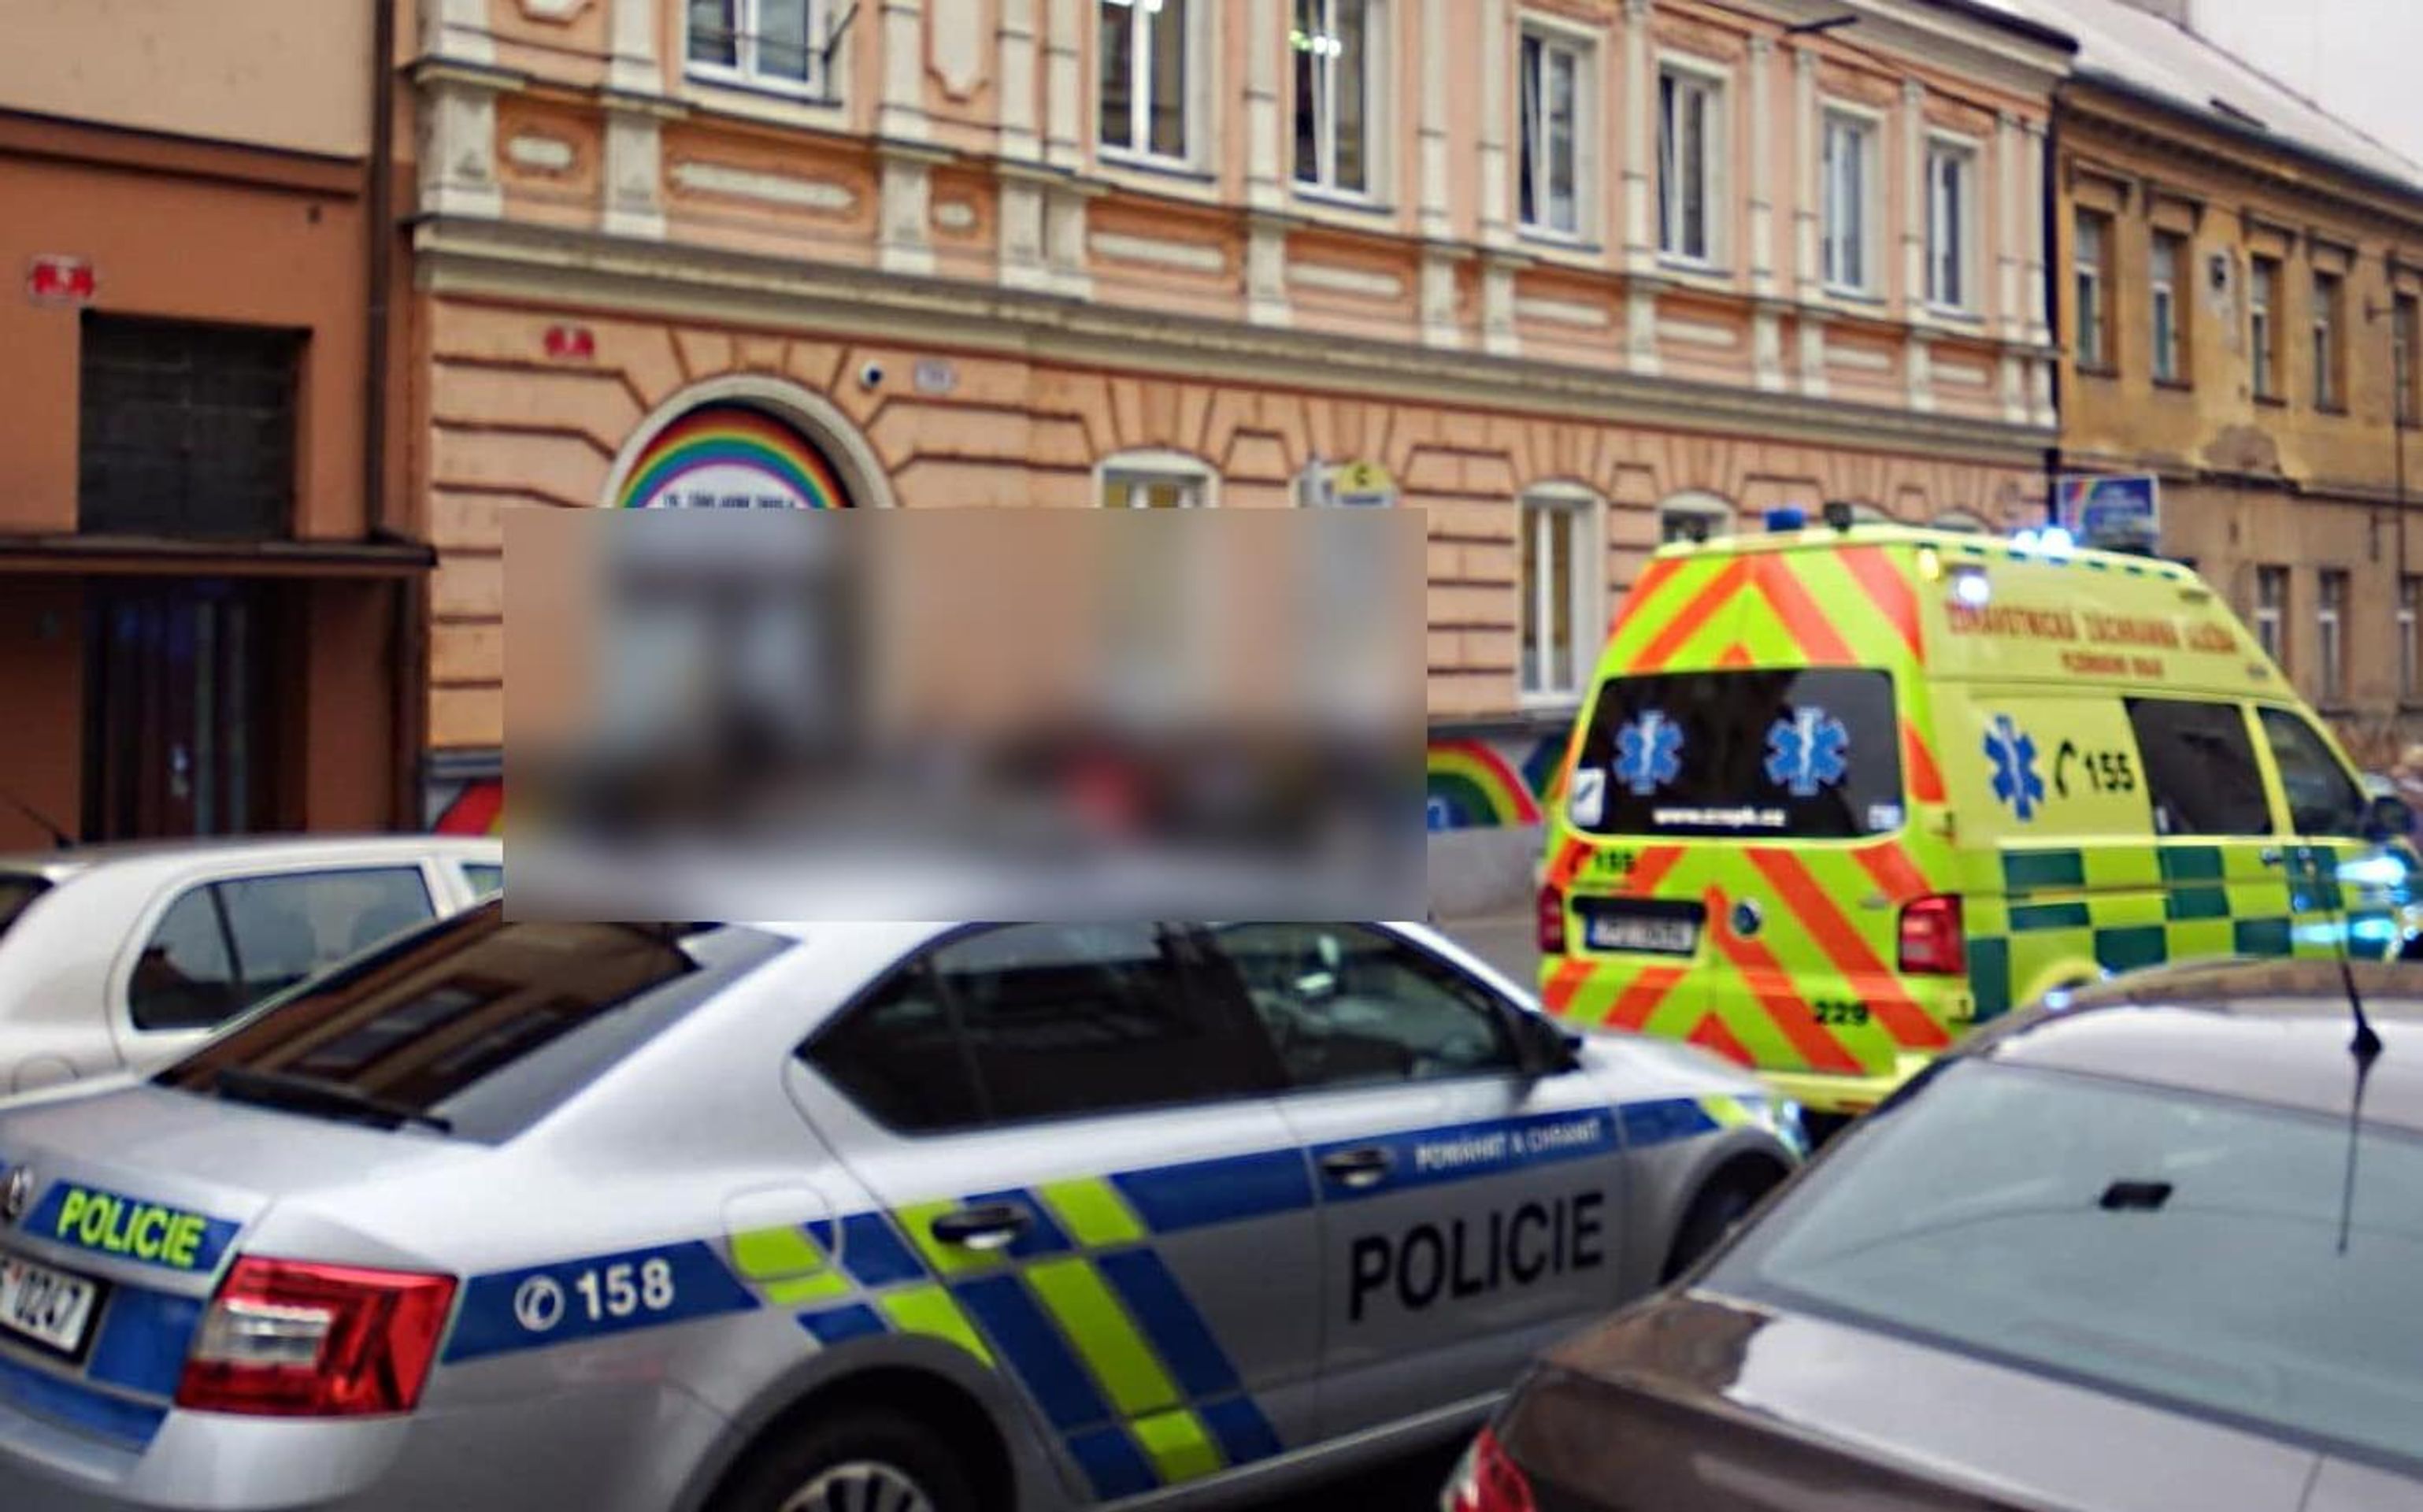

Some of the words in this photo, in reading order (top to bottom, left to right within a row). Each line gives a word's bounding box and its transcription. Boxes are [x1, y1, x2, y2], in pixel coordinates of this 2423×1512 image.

[2084, 751, 2136, 791] 155
[1814, 999, 1869, 1028] 229
[57, 1188, 206, 1269] POLICIE
[1348, 1190, 1605, 1322] POLICIE
[576, 1256, 676, 1321] 158
